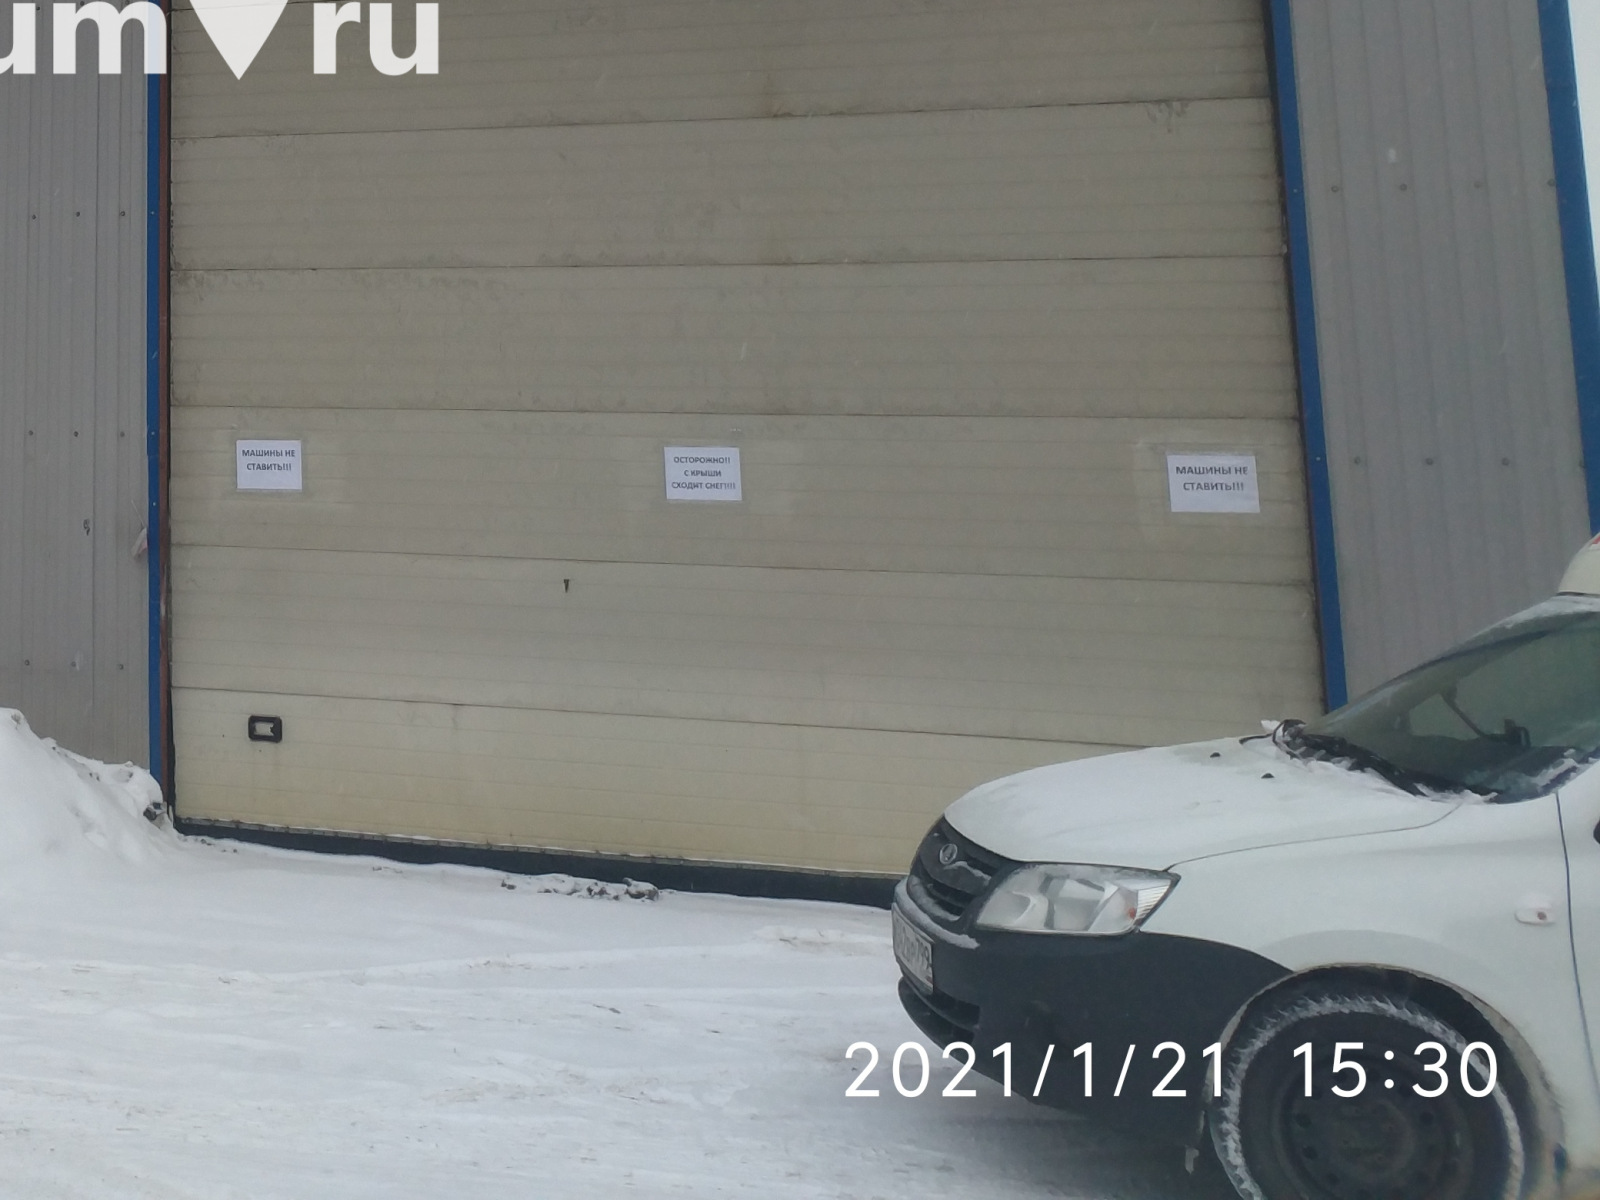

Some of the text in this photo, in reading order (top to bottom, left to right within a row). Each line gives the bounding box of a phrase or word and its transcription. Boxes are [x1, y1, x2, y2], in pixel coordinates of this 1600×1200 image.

[242, 449, 295, 457] МАШИНЫ НЕ
[246, 463, 292, 471] СТАВИТЬ!!!
[1175, 466, 1248, 475] МАШИНЫ НЕ
[684, 469, 722, 477] С КРЫШИ
[671, 481, 703, 490] СХОДИТ
[1183, 482, 1244, 491] СТАВИТЬ!!!
